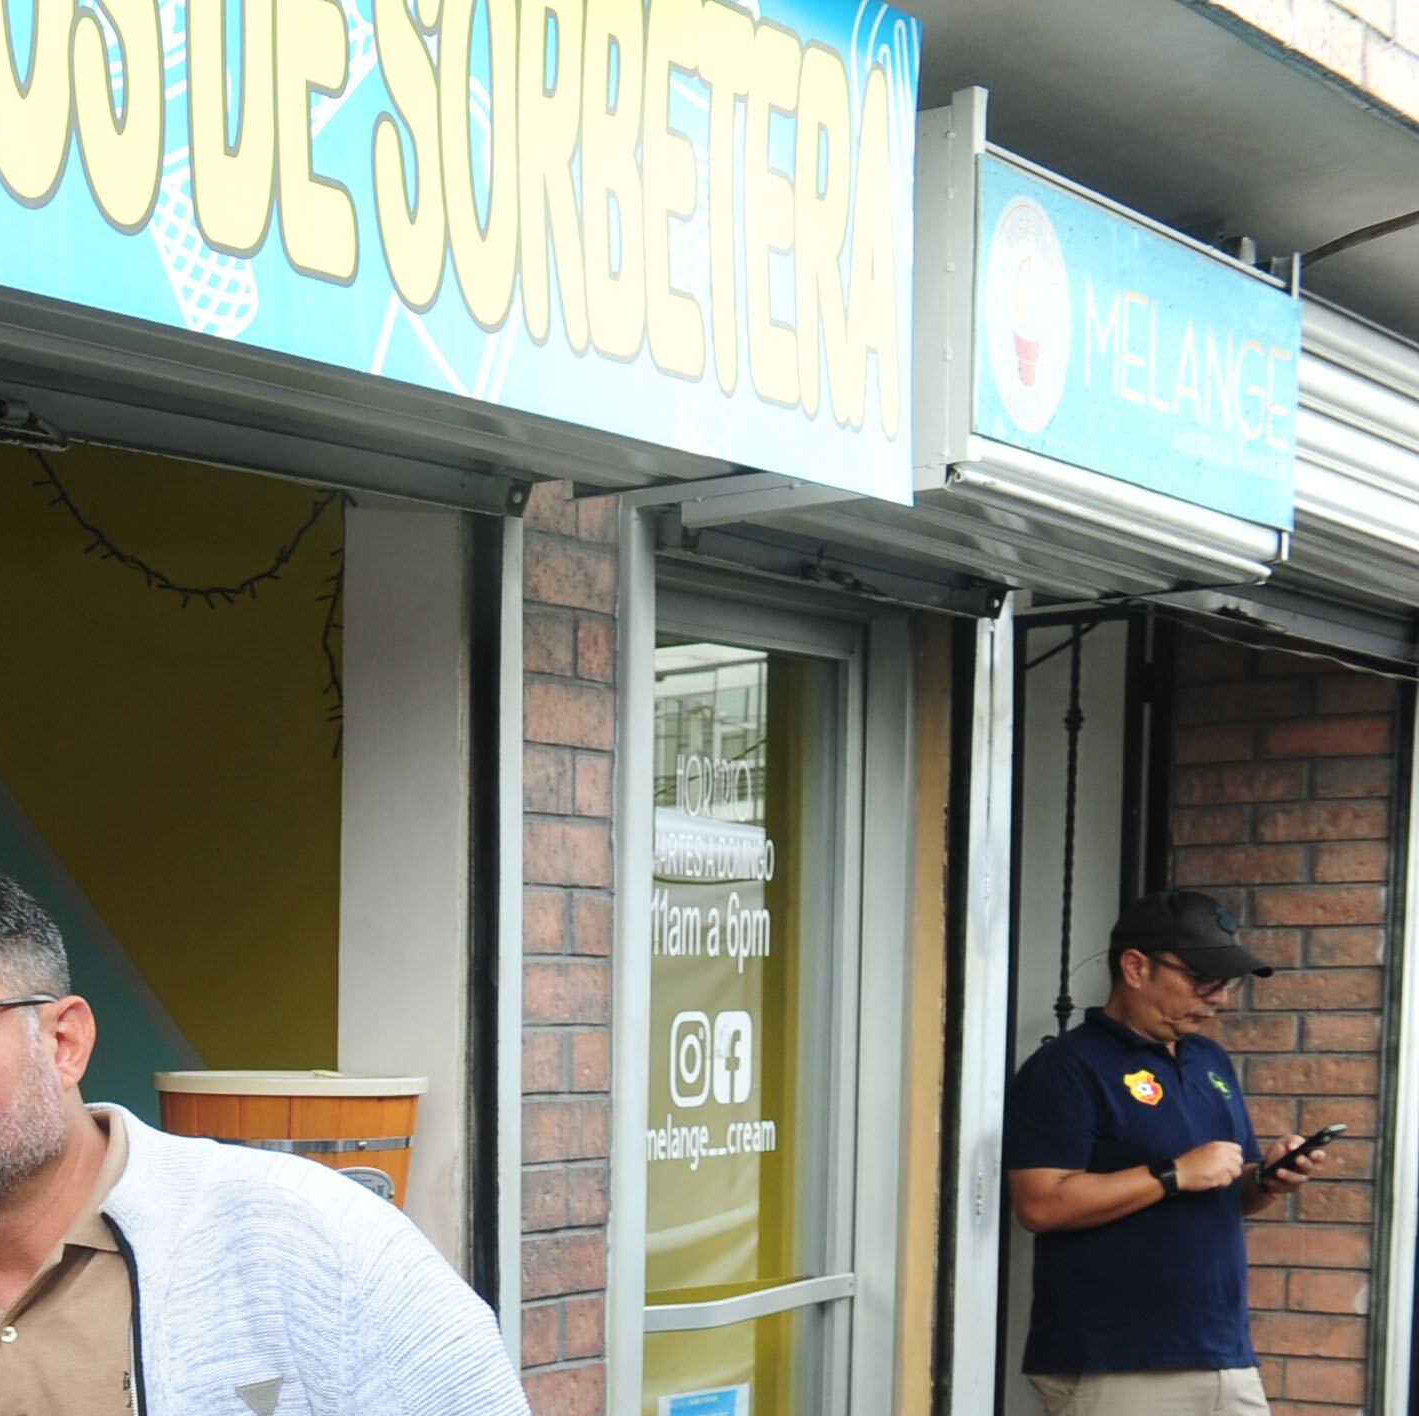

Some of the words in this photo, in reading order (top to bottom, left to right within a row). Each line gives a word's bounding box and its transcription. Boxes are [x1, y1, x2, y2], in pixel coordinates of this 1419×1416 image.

[371, 0, 900, 441] SORBETERA
[1083, 274, 1292, 450] MELANGE
[651, 888, 702, 957] 11am
[706, 907, 720, 957] a
[726, 891, 771, 974] 6pm
